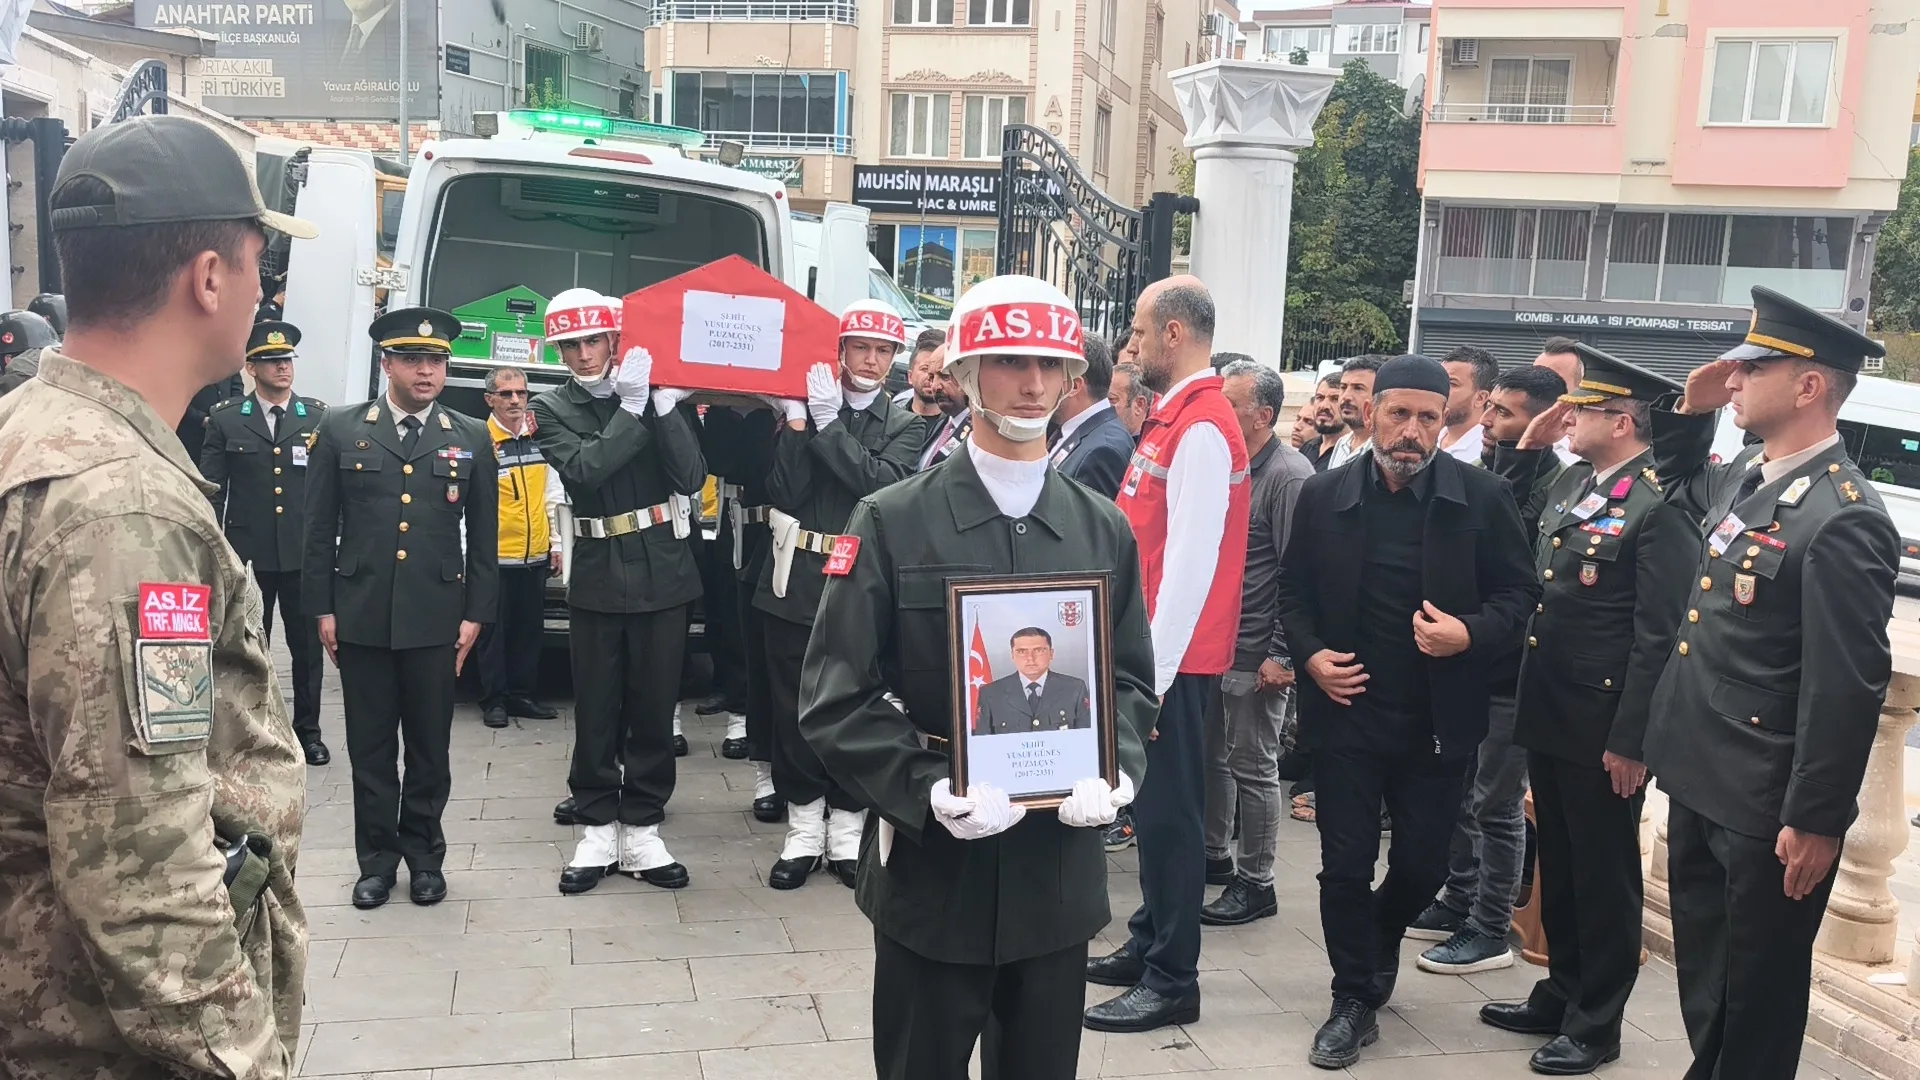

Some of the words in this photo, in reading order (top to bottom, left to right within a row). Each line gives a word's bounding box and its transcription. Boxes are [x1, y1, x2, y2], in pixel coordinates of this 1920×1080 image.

[154, 4, 250, 25] ANAHTAR
[244, 31, 300, 46] BAŞKANLIĞI
[243, 60, 272, 75] AKIL
[221, 78, 282, 96] TÜRKİYE
[323, 81, 351, 91] Yavuz
[354, 79, 420, 92] AĞIRALİOLU
[858, 170, 921, 191] MUHSİN
[925, 174, 994, 198] MARAŞLI
[918, 198, 944, 210] HAC
[946, 200, 956, 210] &
[960, 200, 996, 212] UMRE
[704, 320, 732, 330] YUSUF
[734, 322, 762, 333] GÜNEŞ
[1608, 316, 1622, 326] ISI
[1626, 317, 1680, 329] POMPASI
[708, 340, 754, 352] (2017-2331)
